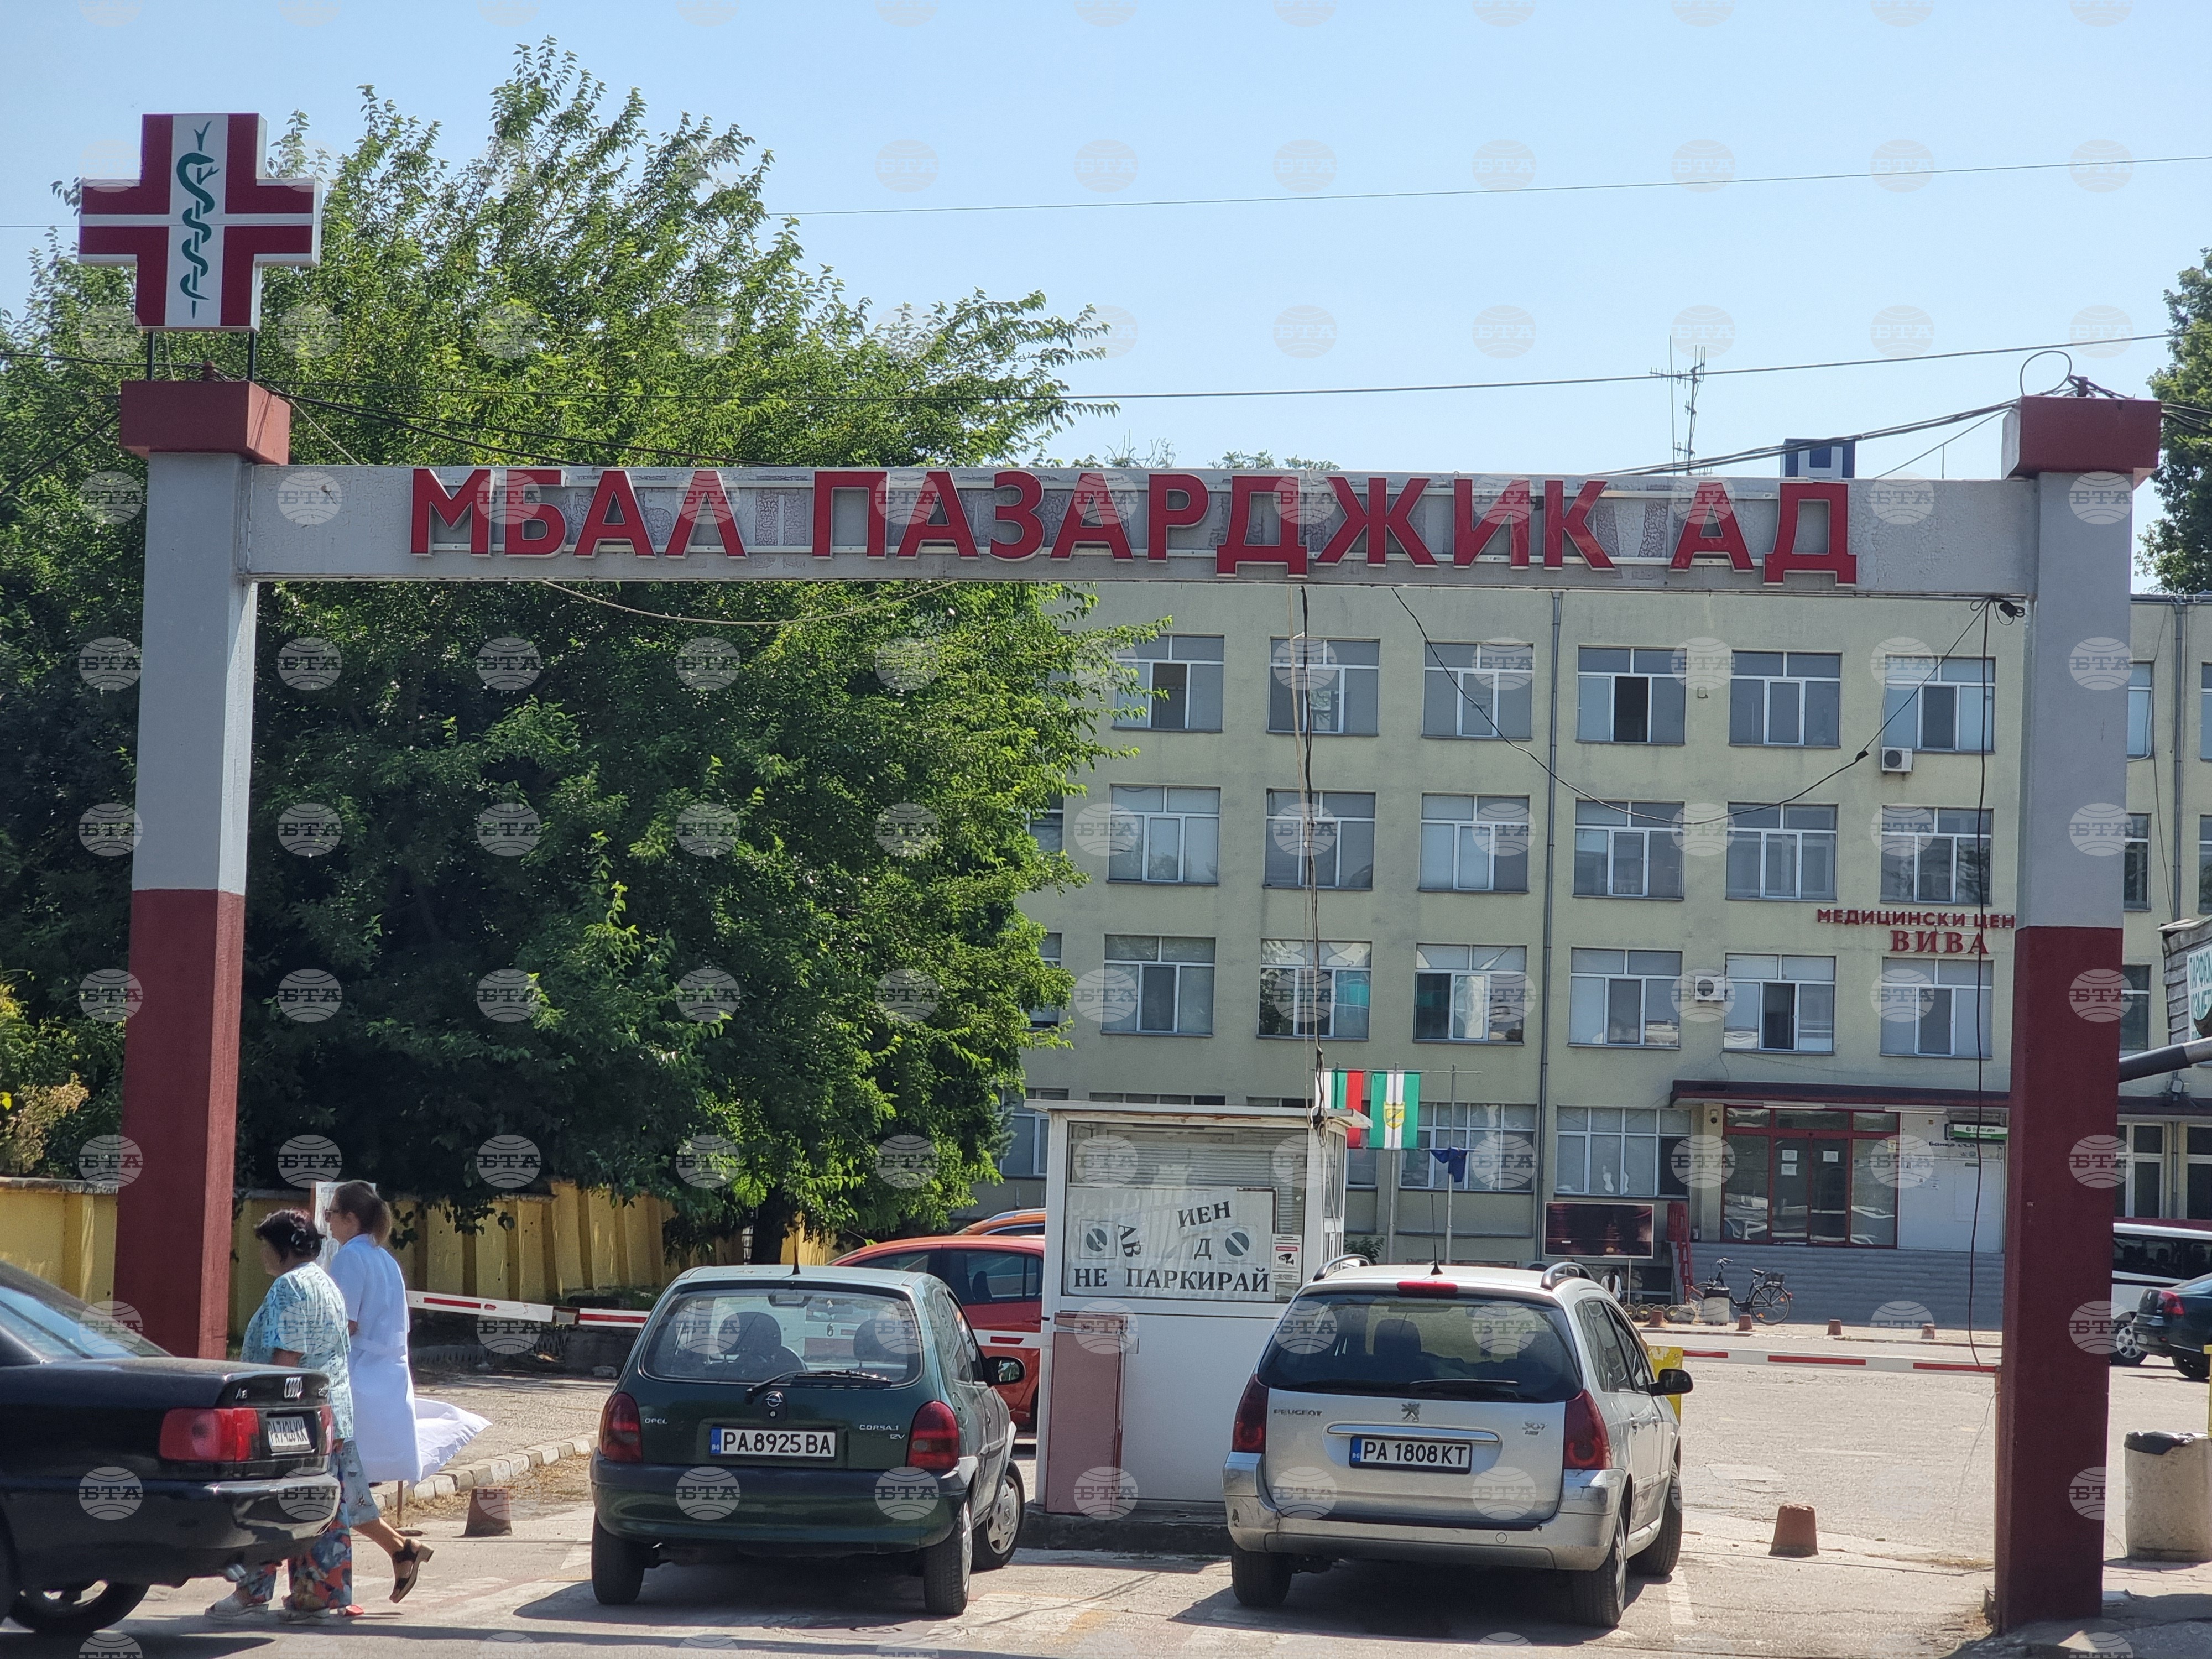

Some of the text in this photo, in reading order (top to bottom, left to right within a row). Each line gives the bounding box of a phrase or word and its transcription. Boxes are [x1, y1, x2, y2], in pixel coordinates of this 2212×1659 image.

[410, 468, 1857, 586] МБАЛ ПАЗАРДЖИК АД
[1817, 909, 1965, 927] МЕДИЦИНСКИ
[1890, 930, 1990, 954] ВИВА
[1177, 1201, 1231, 1228] ИЕН
[1194, 1238, 1212, 1260] Д
[1074, 1268, 1107, 1287] НЕ
[1126, 1267, 1269, 1292] ПАРКИРАЙ
